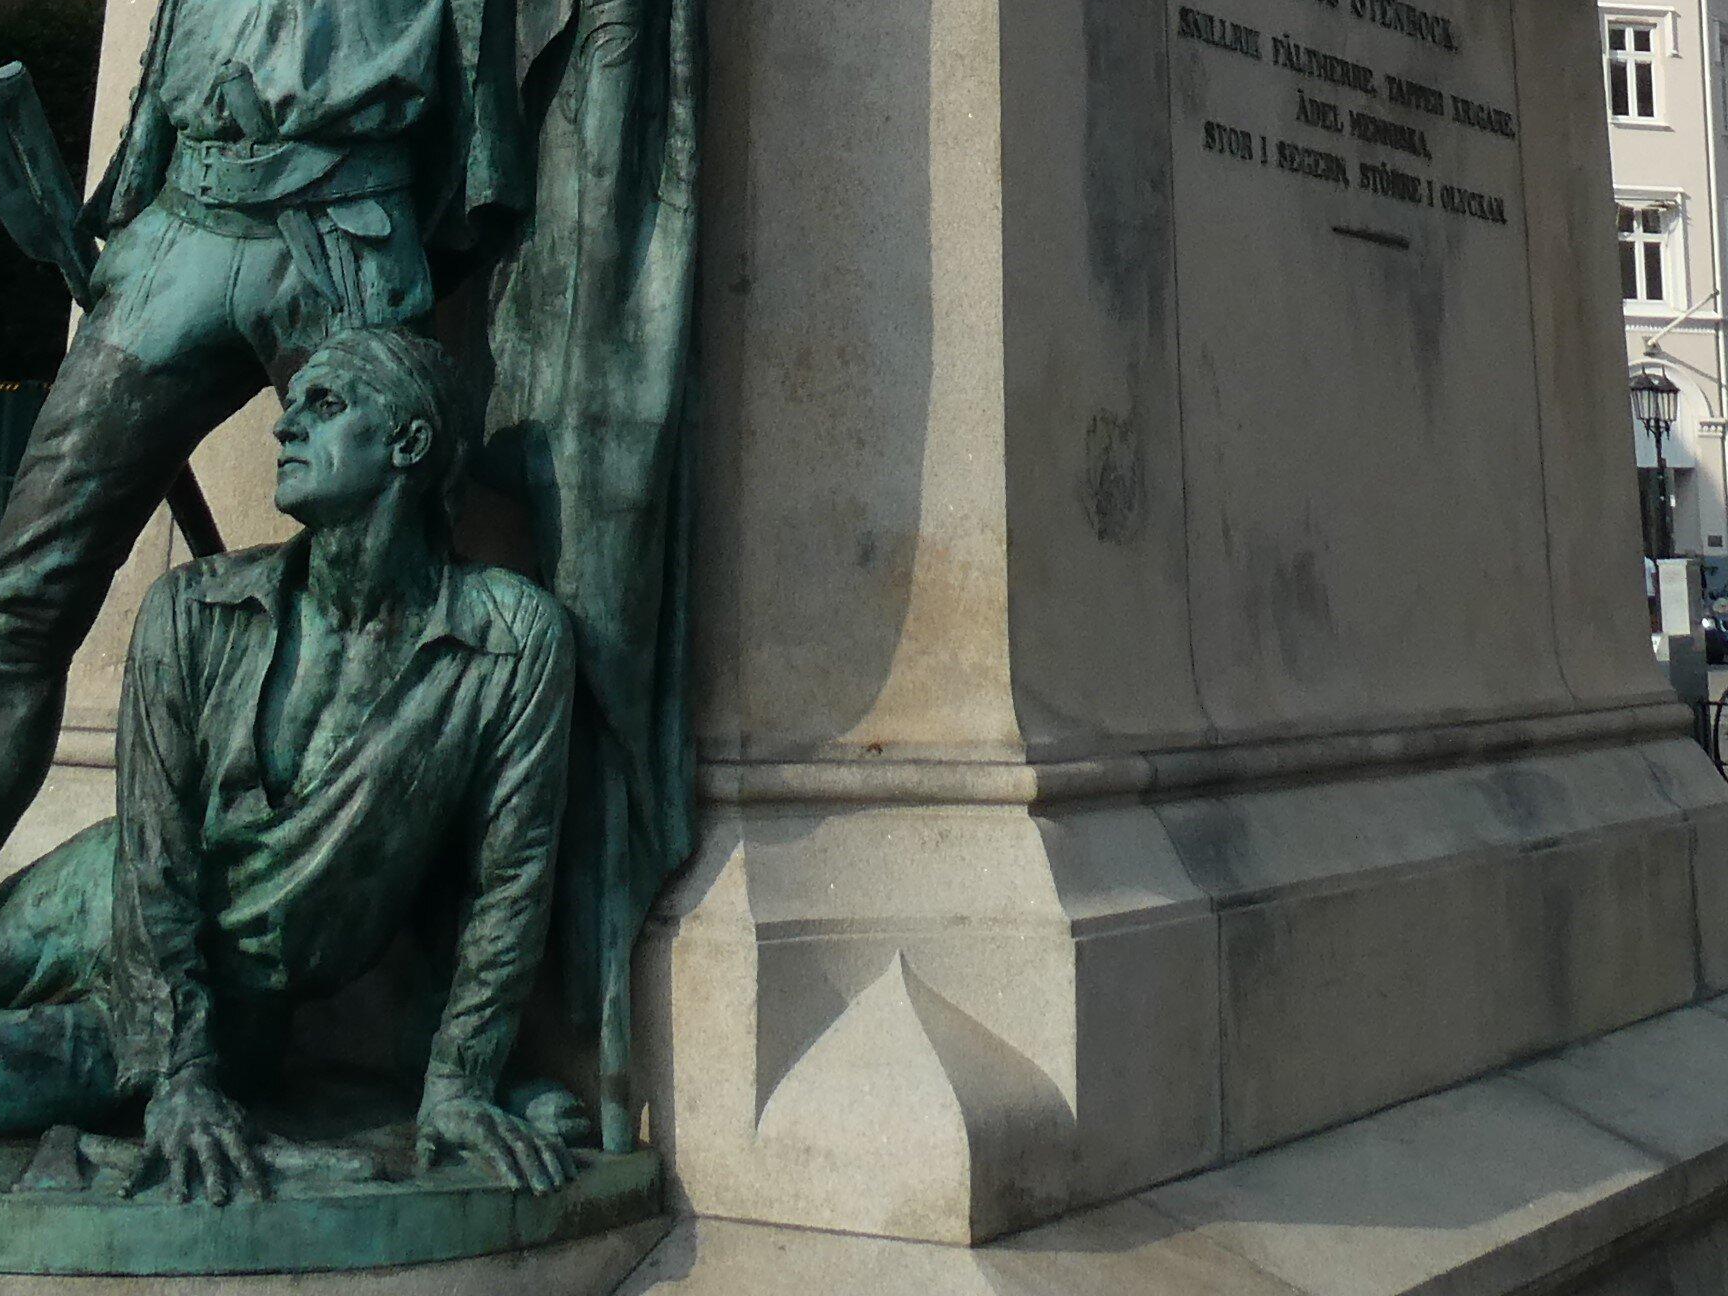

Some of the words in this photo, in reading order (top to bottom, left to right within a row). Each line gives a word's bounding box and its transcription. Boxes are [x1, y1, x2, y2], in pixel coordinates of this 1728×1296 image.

[1203, 119, 1254, 160] STOR
[1260, 135, 1268, 166] I
[1427, 179, 1434, 208] I
